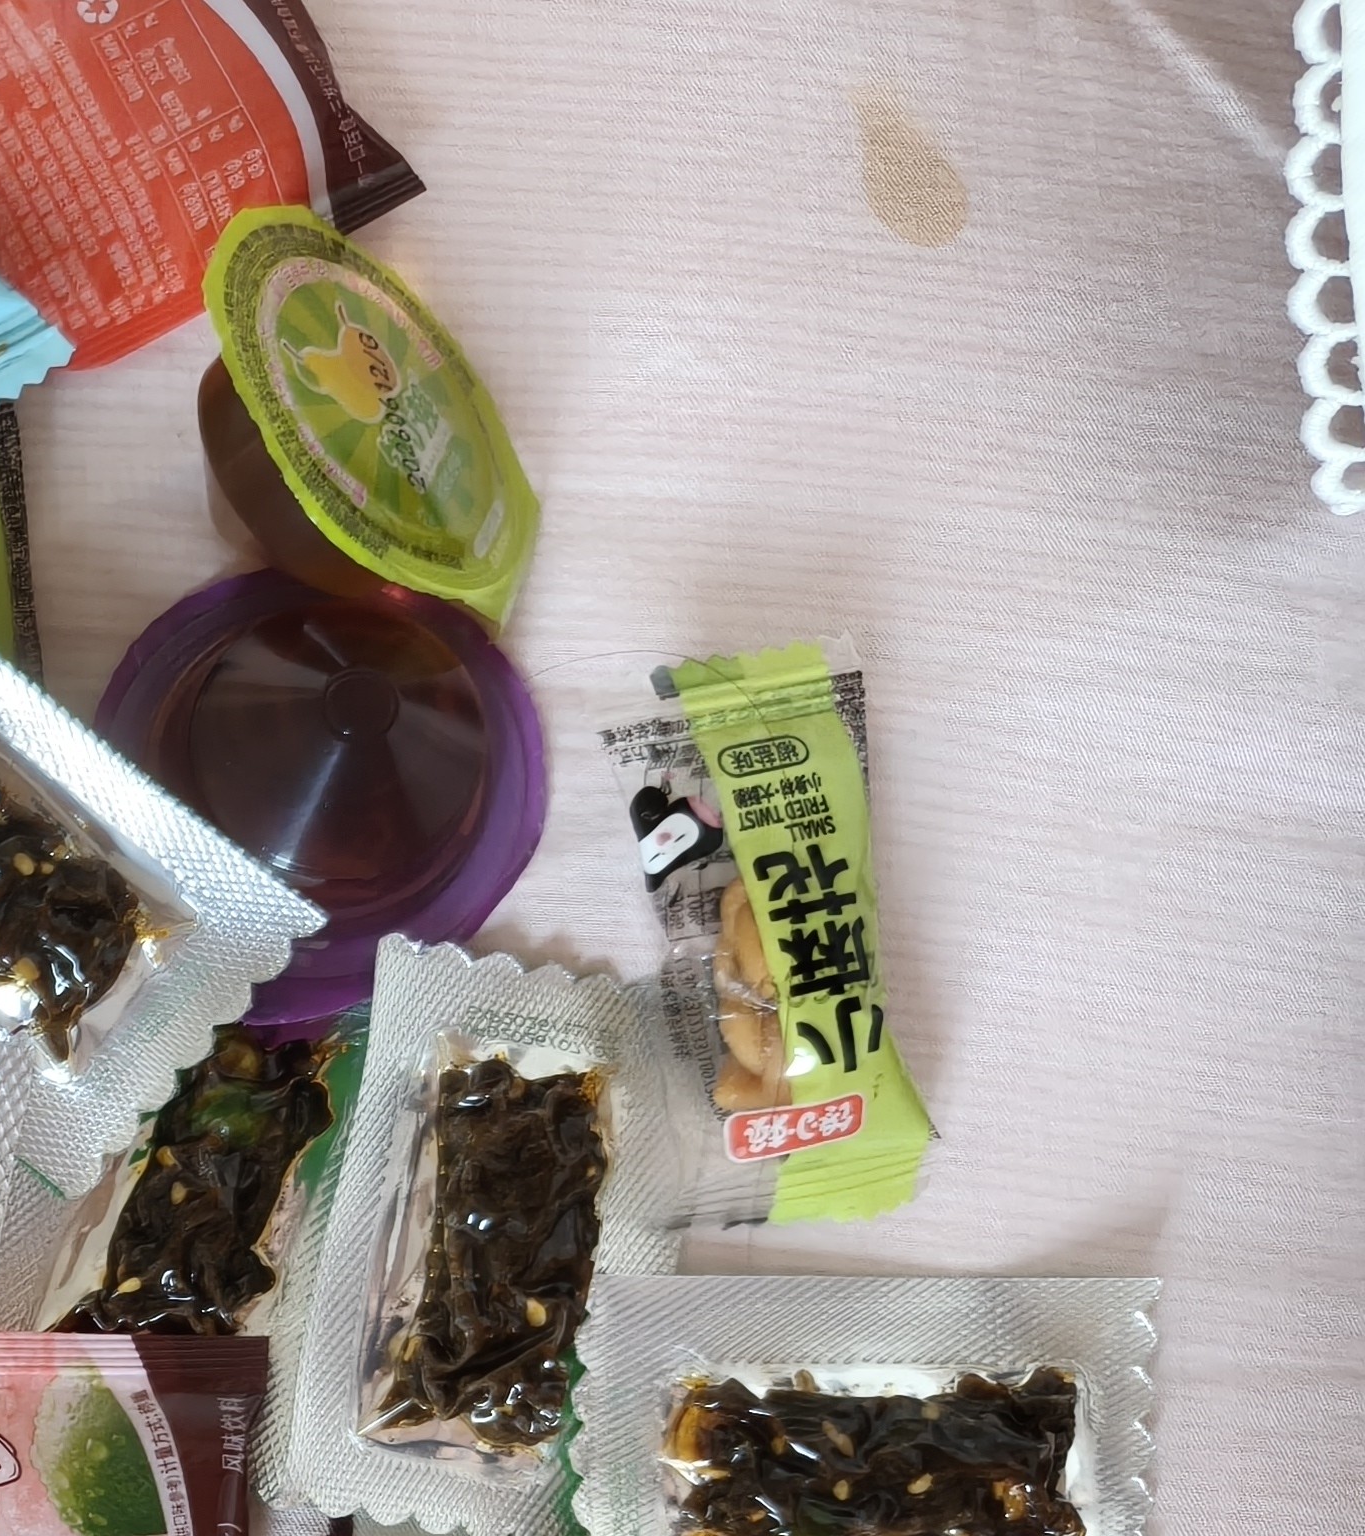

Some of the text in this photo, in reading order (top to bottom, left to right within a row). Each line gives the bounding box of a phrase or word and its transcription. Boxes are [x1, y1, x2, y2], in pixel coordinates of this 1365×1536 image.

[723, 738, 801, 772] 椒盐味
[735, 793, 829, 831] FRIED TWIST
[782, 815, 835, 841] SMALL
[754, 846, 885, 1073] 小麻花
[743, 1100, 855, 1154] 馋小赖
[214, 1393, 246, 1474] 风味饮料
